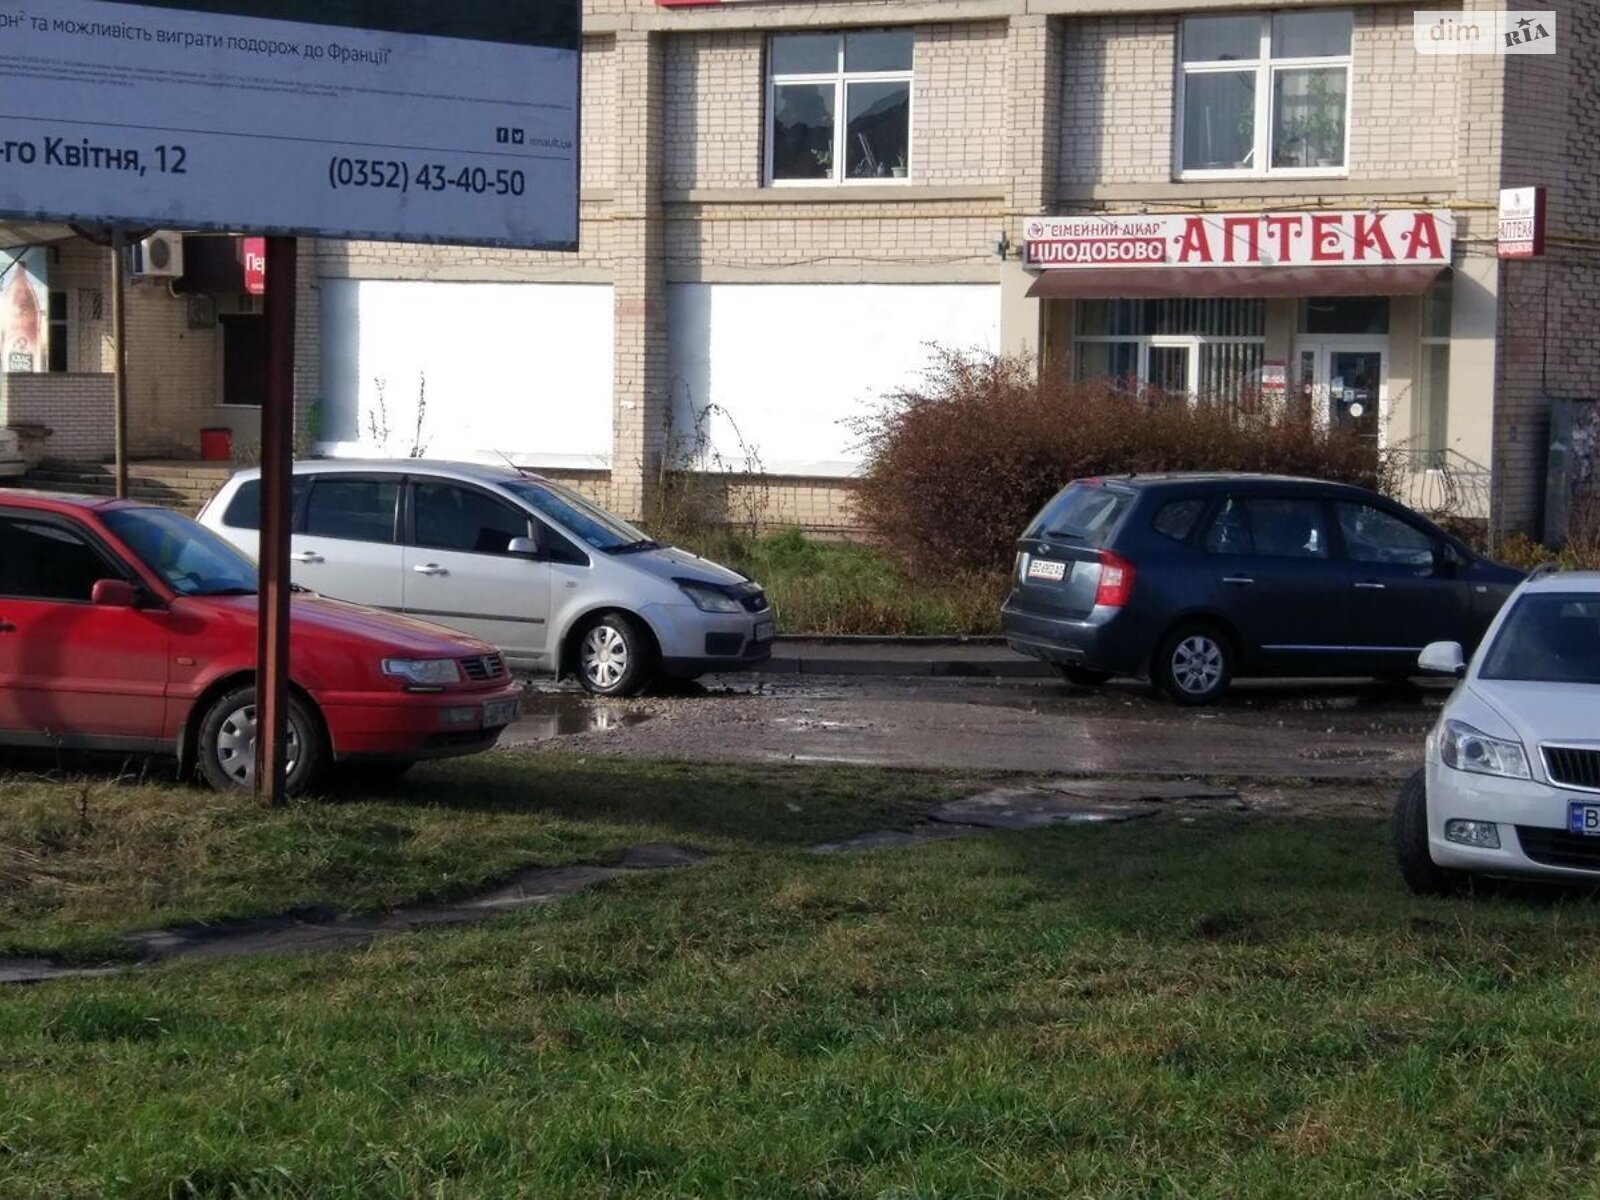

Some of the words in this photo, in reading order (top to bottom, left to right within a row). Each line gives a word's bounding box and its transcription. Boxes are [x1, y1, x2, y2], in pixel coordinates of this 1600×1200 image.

[30, 16, 48, 31] та
[53, 20, 152, 41] можливість
[157, 29, 223, 49] виграти
[228, 36, 300, 57] подорож
[303, 43, 324, 58] до
[43, 136, 146, 176] Квітня,
[154, 146, 187, 174] 12
[329, 156, 409, 193] (0352)
[416, 164, 525, 196] 43-40-50
[1030, 241, 1163, 262] ЦІЛОДОБОВО
[1173, 212, 1445, 263] АПТЕКА
